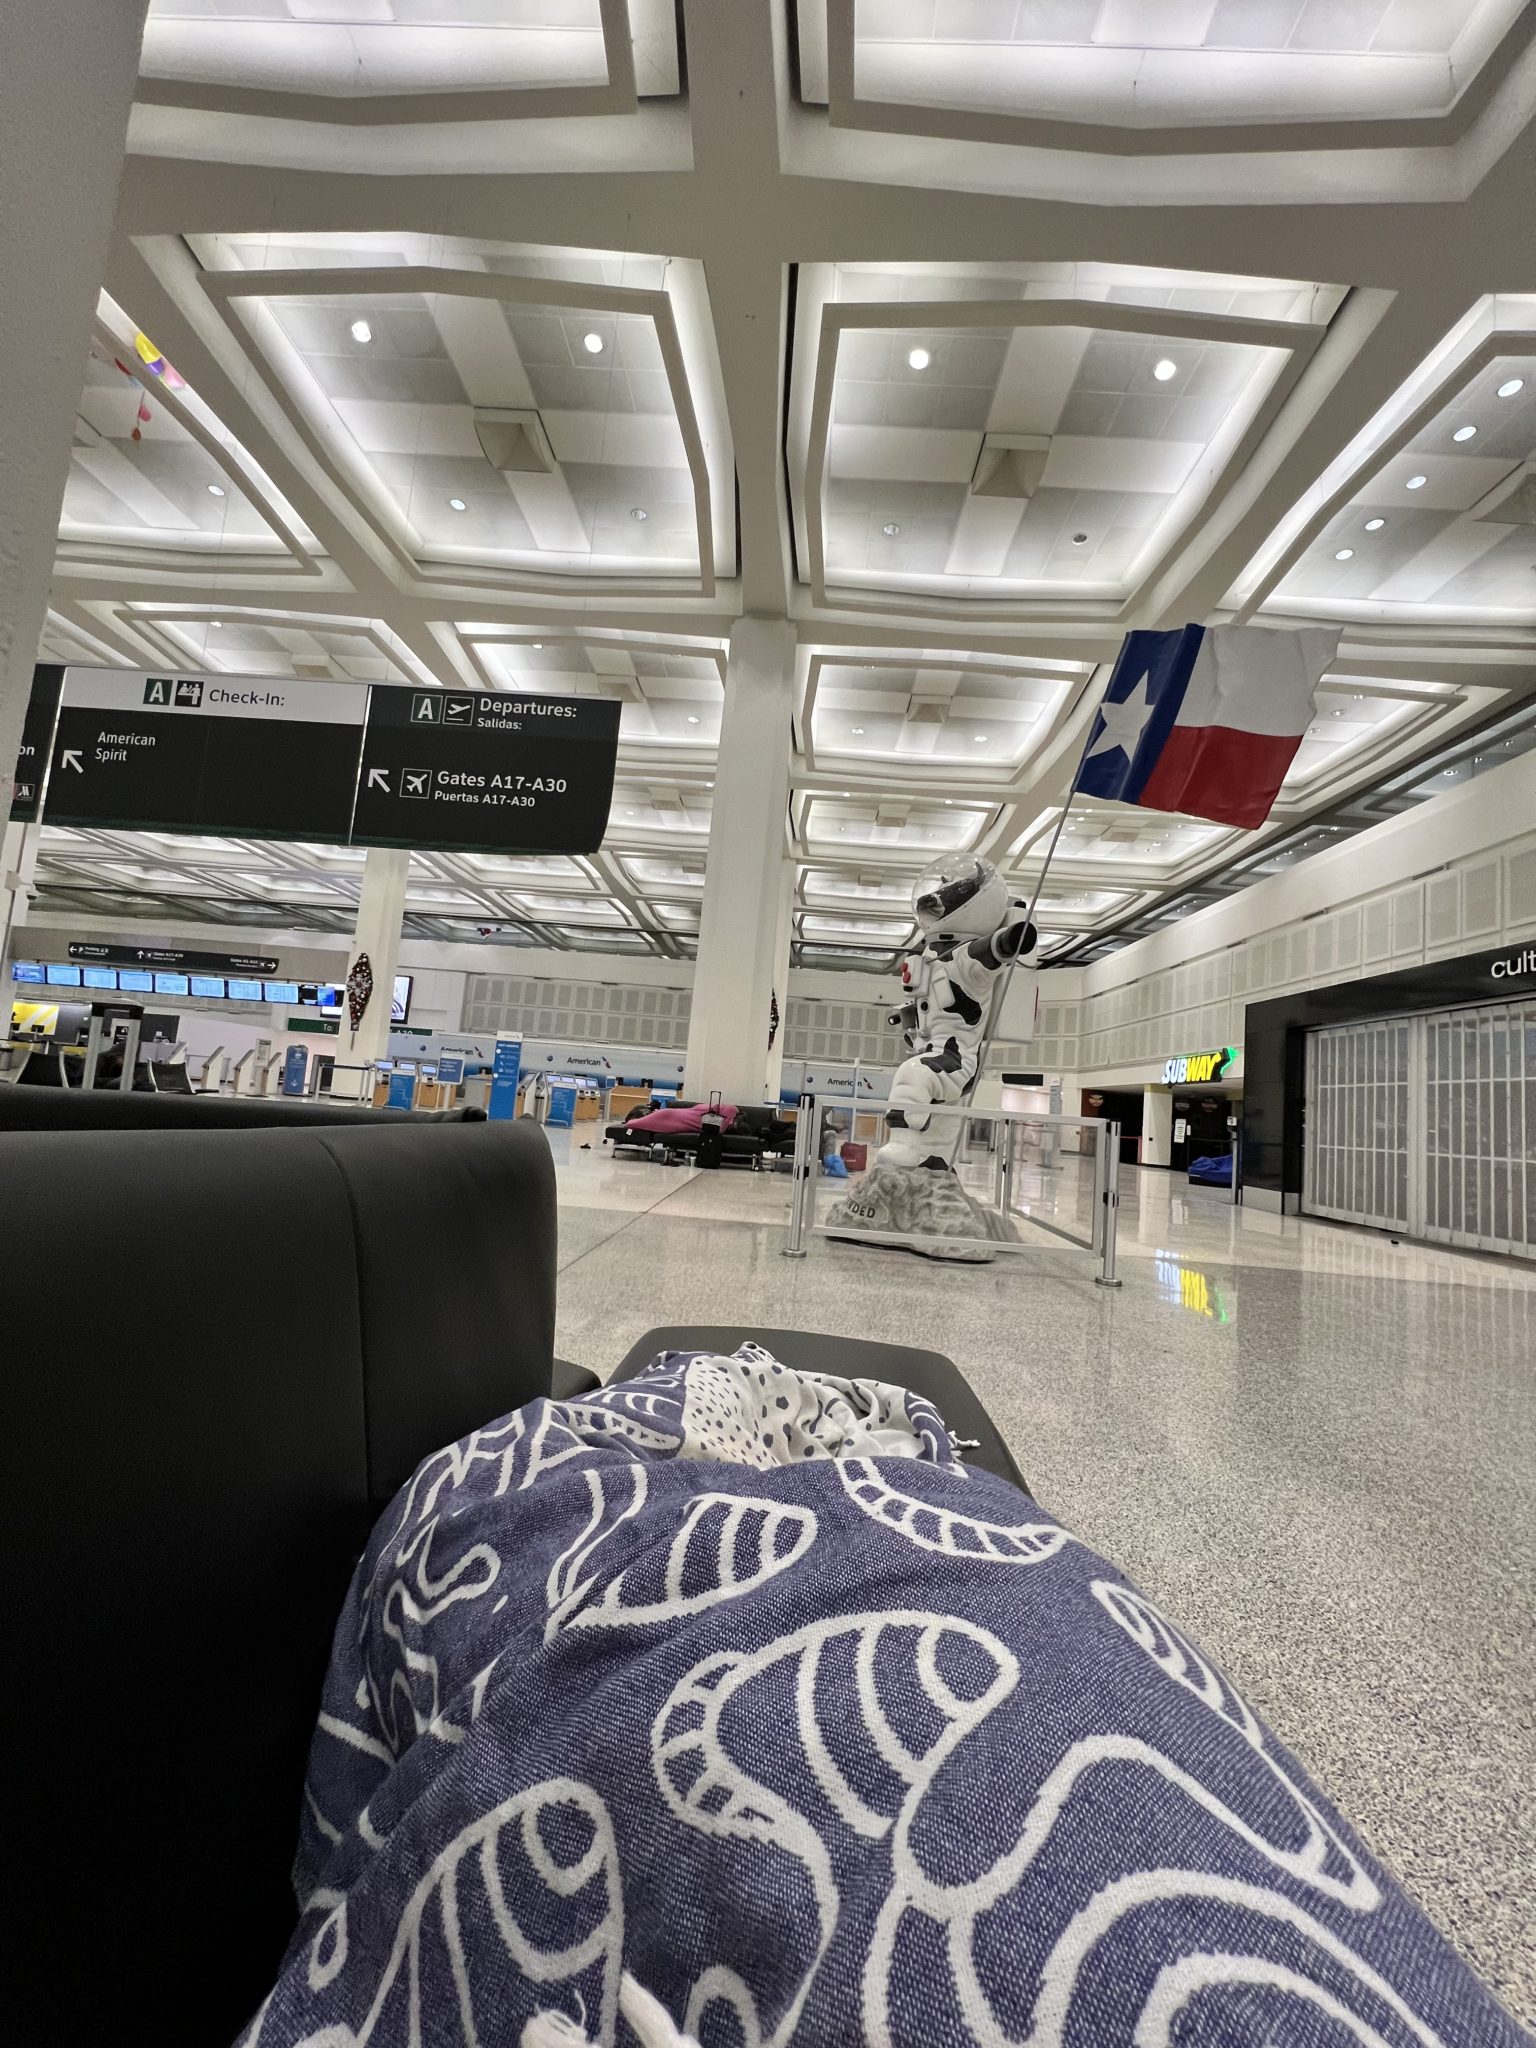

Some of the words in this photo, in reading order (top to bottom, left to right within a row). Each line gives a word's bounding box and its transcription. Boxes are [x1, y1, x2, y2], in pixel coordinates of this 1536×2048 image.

[149, 681, 164, 703] A
[209, 689, 285, 706] Check-In:
[417, 698, 433, 720] A
[480, 697, 577, 718] Departures:
[477, 717, 522, 730] Salidas:
[97, 731, 156, 746] American
[95, 747, 127, 763] Spirit
[437, 770, 486, 787] Gates
[490, 774, 567, 793] A17-A30
[434, 790, 479, 804] Puertas
[482, 794, 535, 807] A17-A30
[1491, 950, 1536, 978] cult
[566, 1056, 601, 1066] American
[1161, 1052, 1222, 1085] SUBWAY
[827, 1078, 863, 1088] Americn
